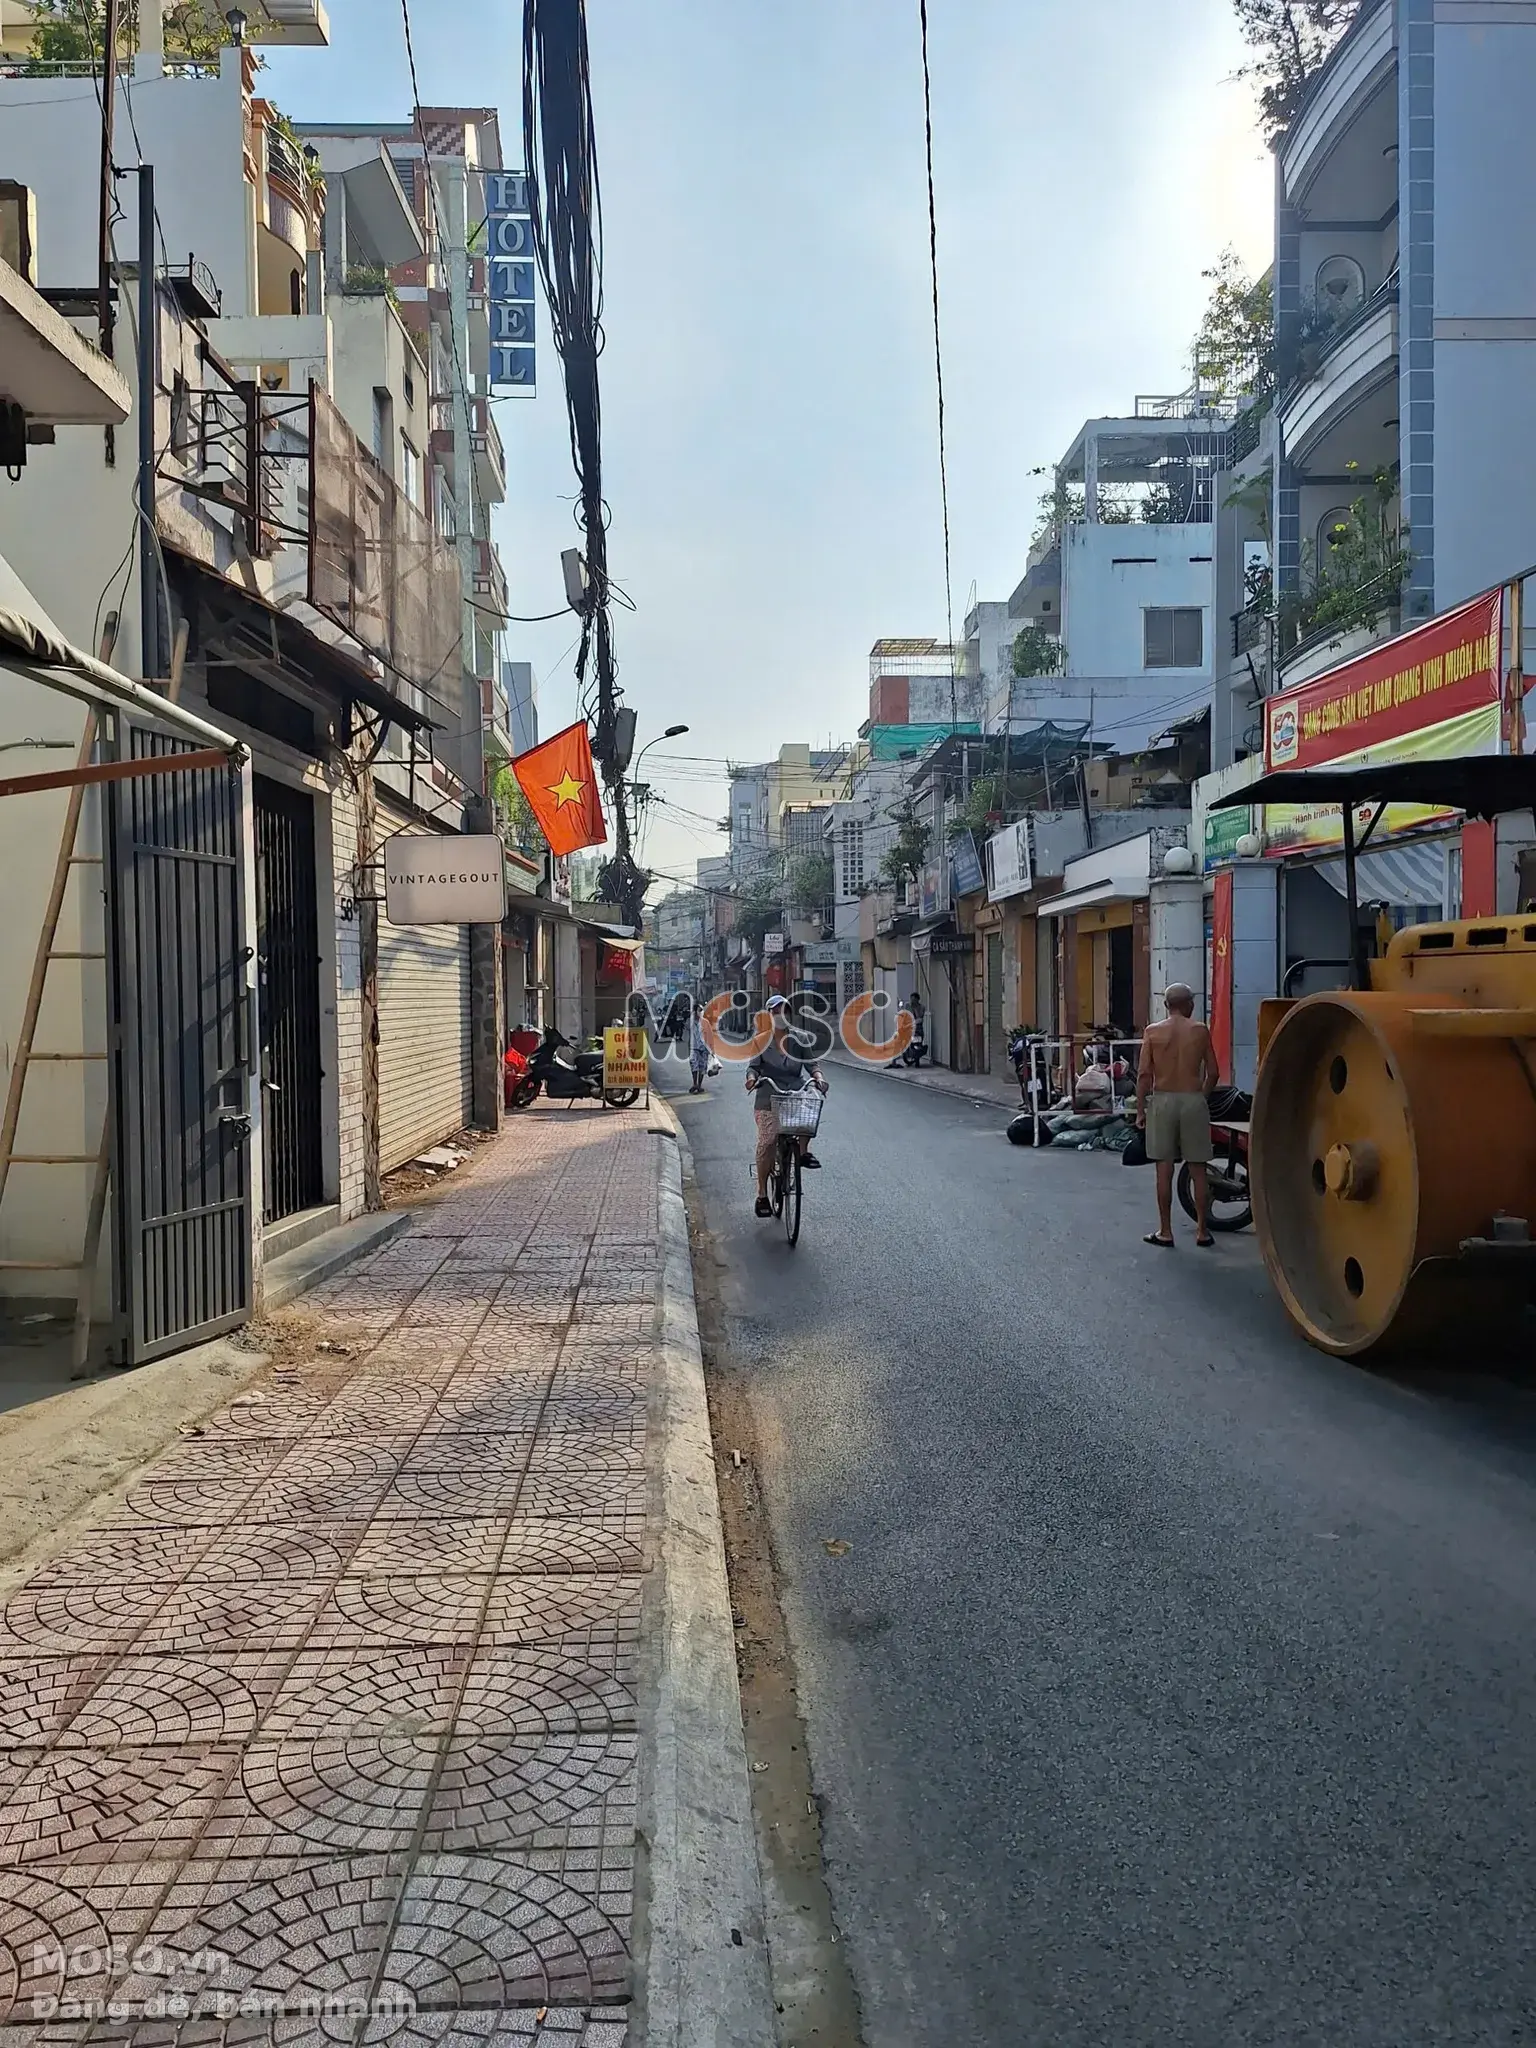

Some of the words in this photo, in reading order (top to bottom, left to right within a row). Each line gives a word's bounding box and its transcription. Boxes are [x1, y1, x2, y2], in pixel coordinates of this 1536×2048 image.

[494, 176, 526, 380] HOTEL
[1357, 681, 1373, 723] VIỆT
[1373, 676, 1392, 713] NAM
[1393, 668, 1421, 708] QUANG
[1423, 656, 1443, 693] VINH
[1445, 638, 1473, 685] MUÔN
[390, 873, 499, 885] VINTAGEGOUT
[340, 897, 354, 923] 58
[607, 1062, 646, 1071] NHANH
